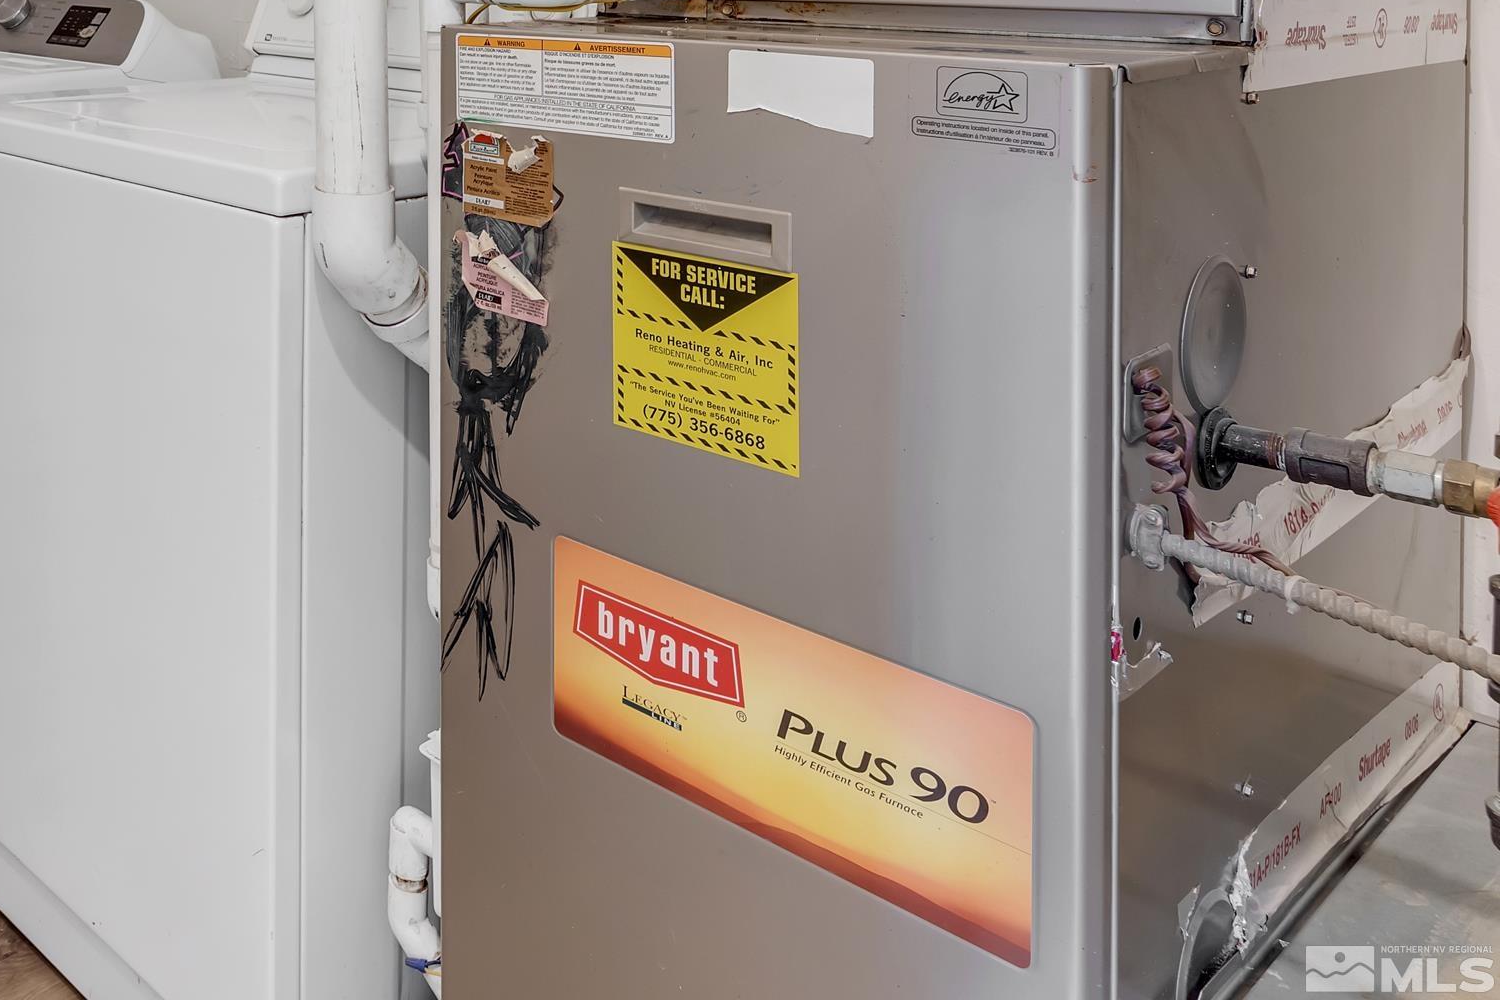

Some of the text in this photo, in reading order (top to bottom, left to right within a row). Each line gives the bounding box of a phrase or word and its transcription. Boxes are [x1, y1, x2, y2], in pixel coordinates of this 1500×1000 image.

[497, 39, 526, 48] WARNING
[589, 44, 646, 54] AVERTISSEMENT
[1285, 20, 1327, 50] Shurtape
[948, 91, 994, 110] energy
[916, 119, 941, 128] Operating
[941, 122, 970, 130] instructions
[998, 127, 1014, 135] inside
[651, 257, 757, 294] FOR SERVICE
[680, 283, 725, 310] CALL:
[635, 328, 774, 369] Reno Heating & Air, Inc
[648, 344, 757, 377] RESIDENTIAL COMMERCIAL
[667, 359, 737, 381] www.renohvac.com
[649, 386, 676, 399] Service
[678, 393, 704, 407] You've
[706, 400, 726, 412] Been
[729, 405, 760, 423] Waiting
[664, 399, 741, 426] NV License #56404
[642, 403, 766, 450] (775) 356-6868
[598, 600, 719, 688] bryant
[622, 685, 682, 722] LEGACY
[651, 711, 682, 731] LINE
[777, 708, 990, 824] PLUS 90
[1358, 737, 1392, 782] Shurtape
[774, 744, 924, 819] Highly Efficient Gas Furnace
